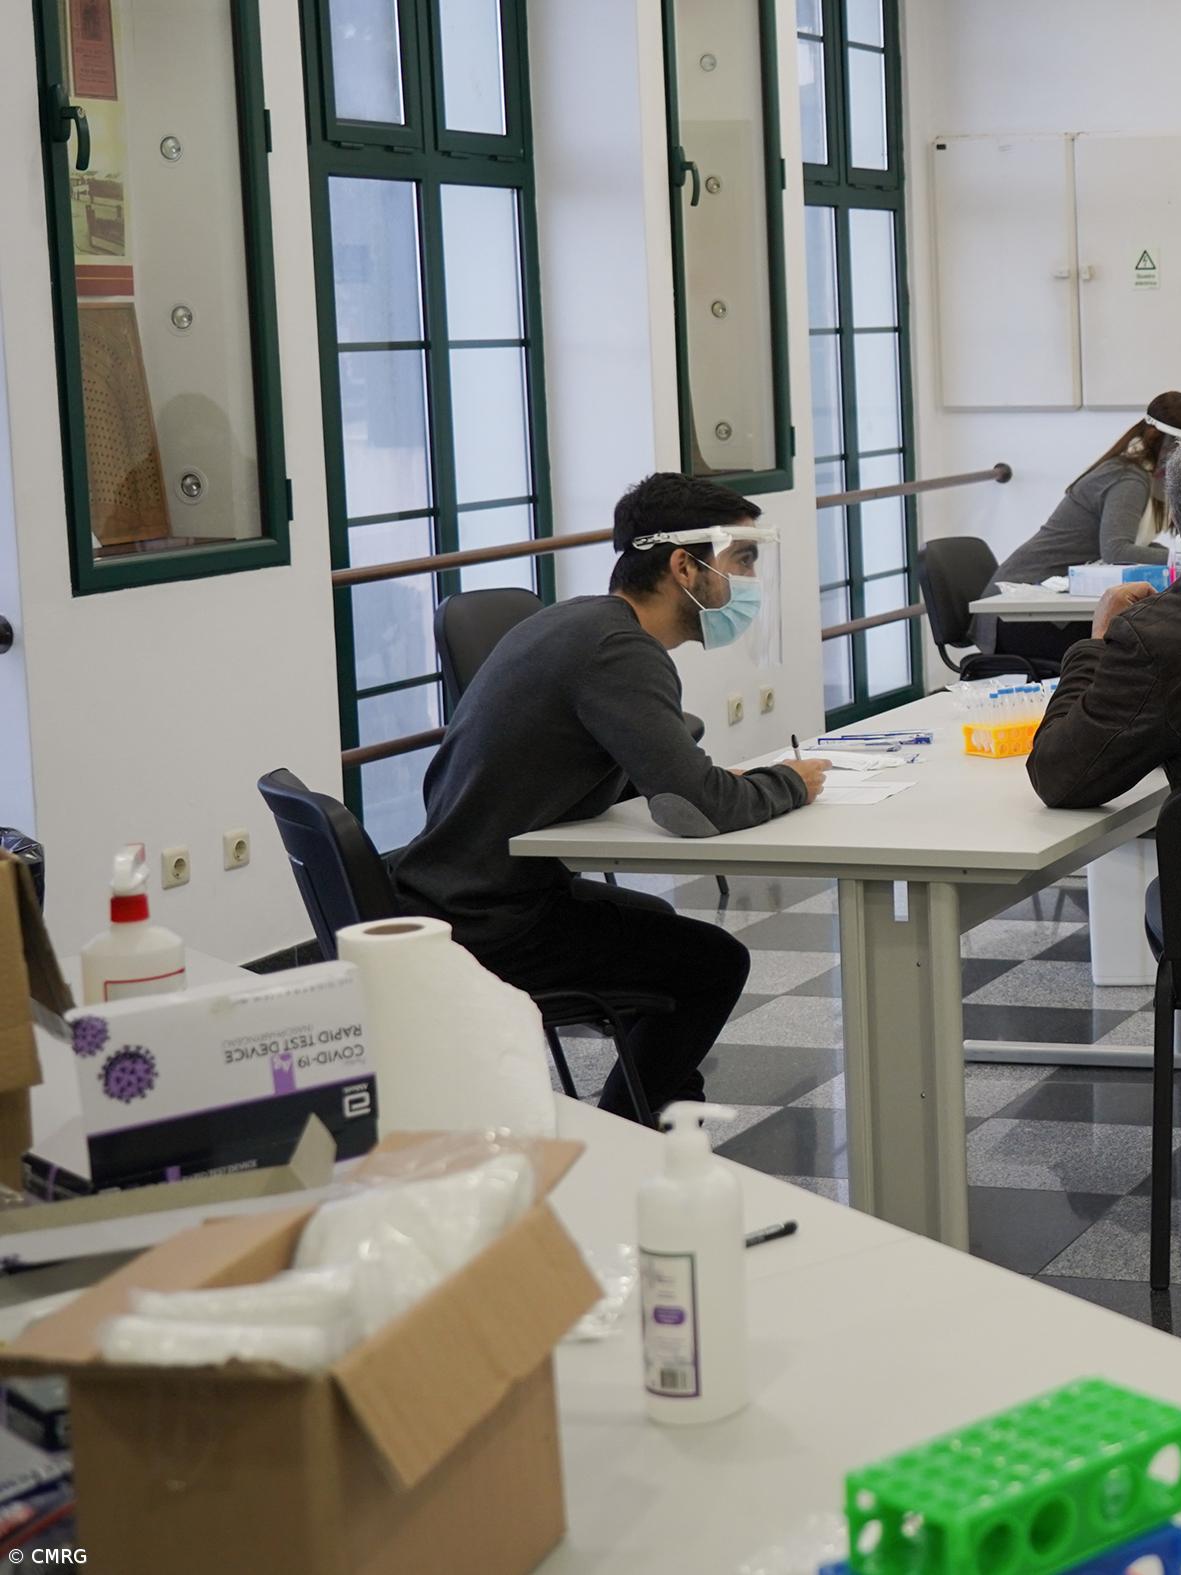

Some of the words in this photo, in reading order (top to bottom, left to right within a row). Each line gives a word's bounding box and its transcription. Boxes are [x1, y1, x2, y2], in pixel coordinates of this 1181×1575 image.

[281, 1034, 315, 1051] TEST
[318, 1024, 362, 1044] RAPID
[224, 1041, 280, 1063] DEVICE
[297, 1044, 365, 1068] COVID-19
